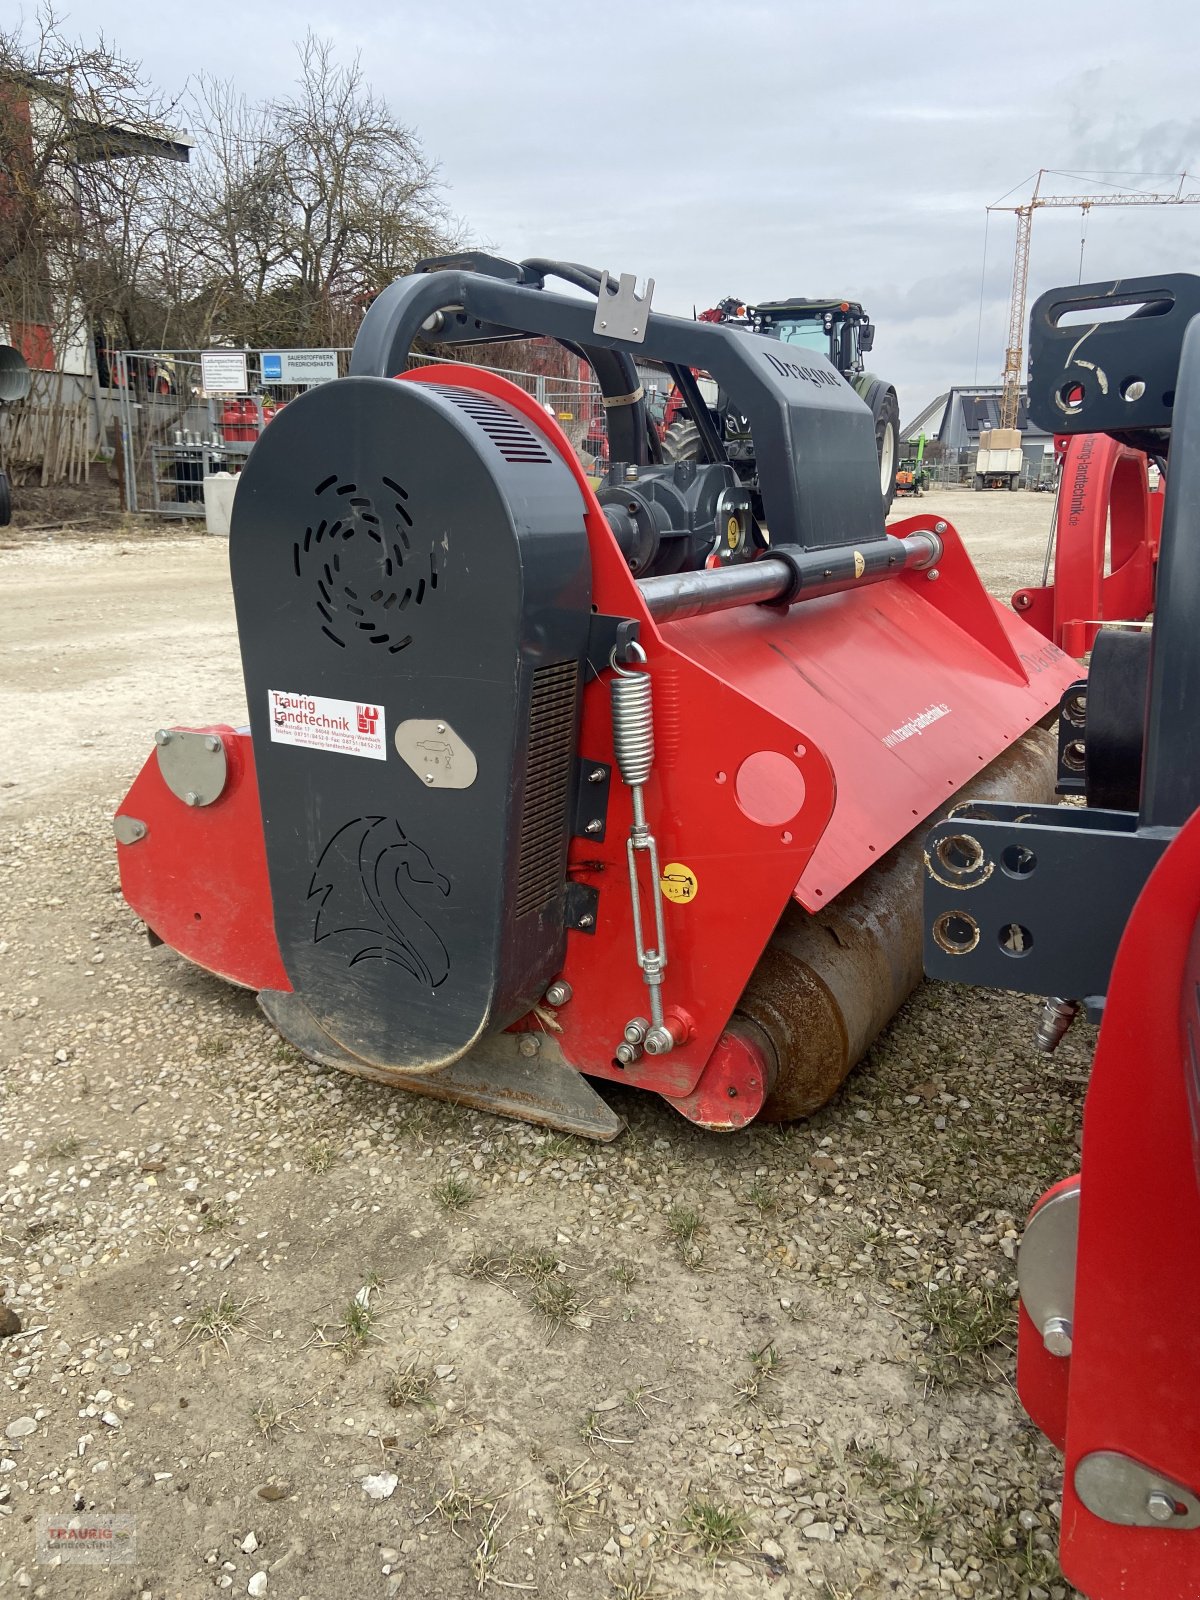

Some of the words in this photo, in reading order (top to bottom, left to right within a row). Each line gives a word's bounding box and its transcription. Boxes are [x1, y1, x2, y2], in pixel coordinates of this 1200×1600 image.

[762, 352, 842, 389] Dragone
[272, 692, 316, 714] Traurig
[274, 708, 351, 731] Landtechnik
